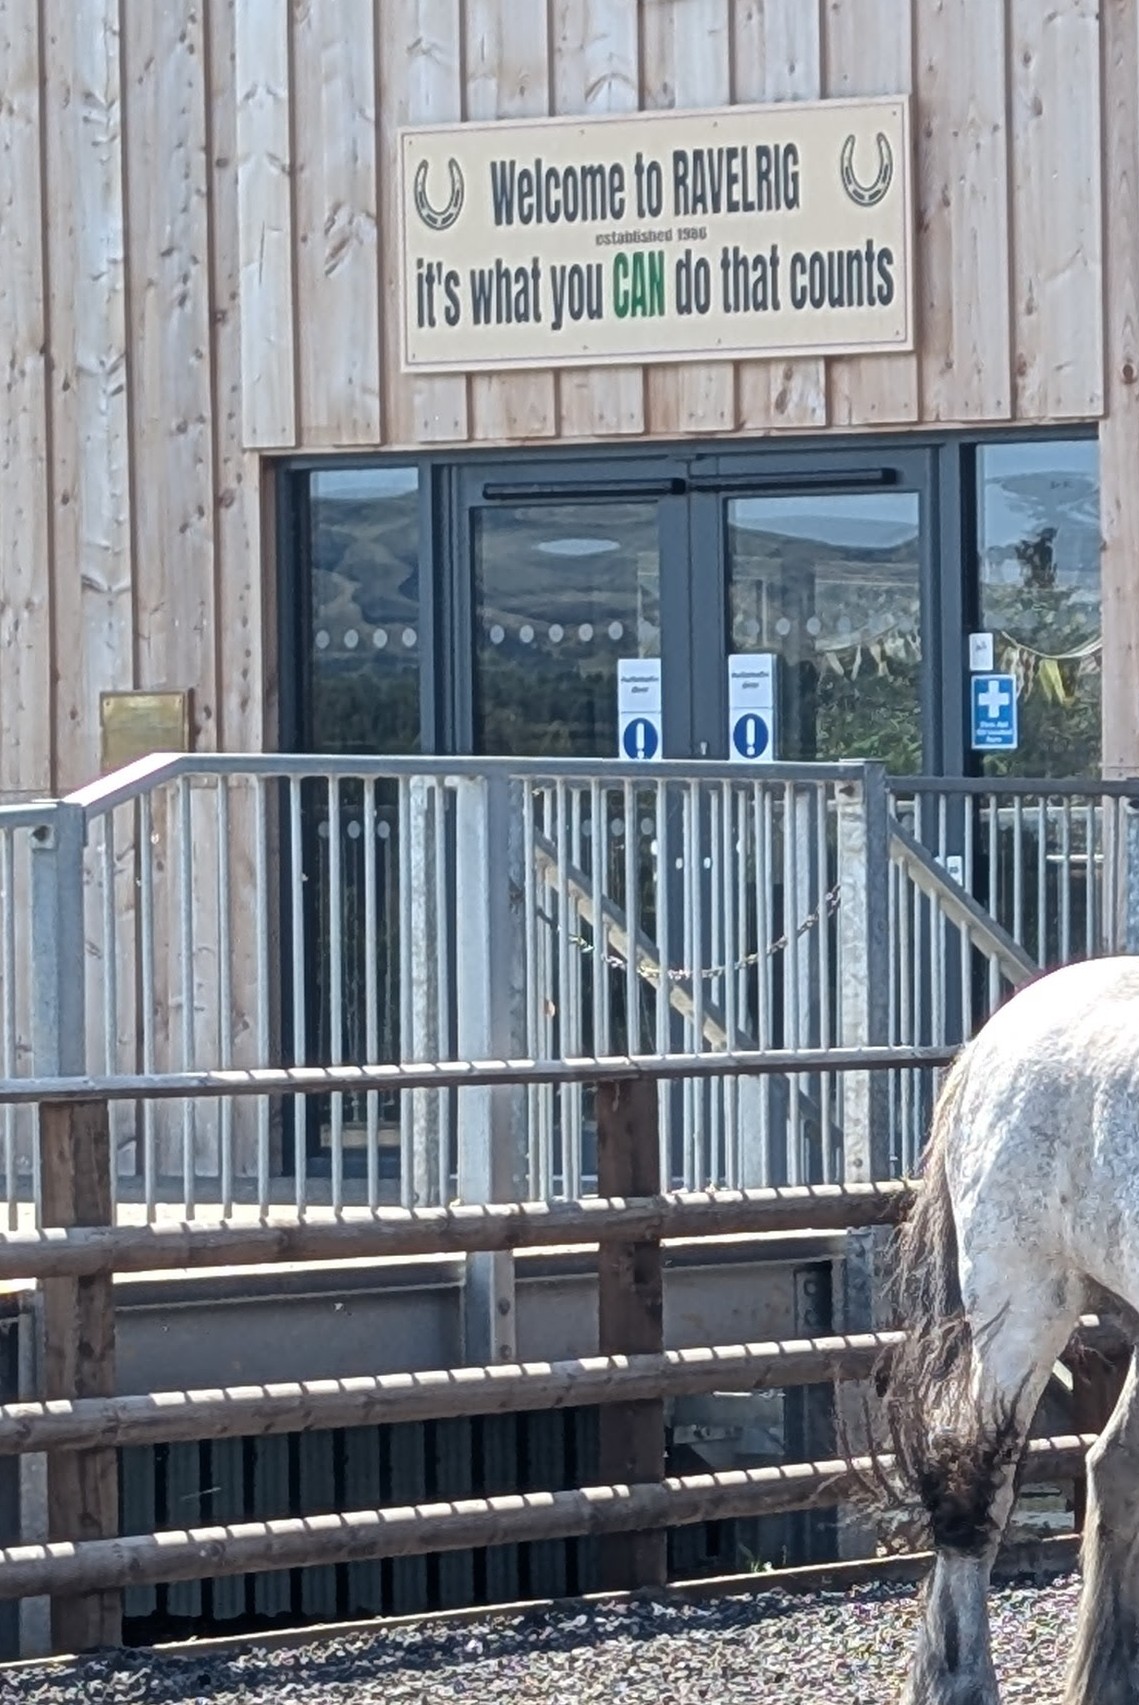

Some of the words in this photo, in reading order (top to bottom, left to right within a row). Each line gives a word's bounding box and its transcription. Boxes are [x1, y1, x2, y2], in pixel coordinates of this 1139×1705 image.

[490, 158, 626, 227] Welcome
[634, 152, 663, 219] to
[672, 142, 800, 217] RAVELRIG
[595, 228, 673, 246] established
[416, 257, 461, 329] it's
[469, 256, 542, 326] what
[550, 263, 603, 331] you
[612, 250, 665, 319] CAN
[675, 248, 711, 316] do
[720, 244, 781, 314] that
[789, 238, 894, 310] counts
